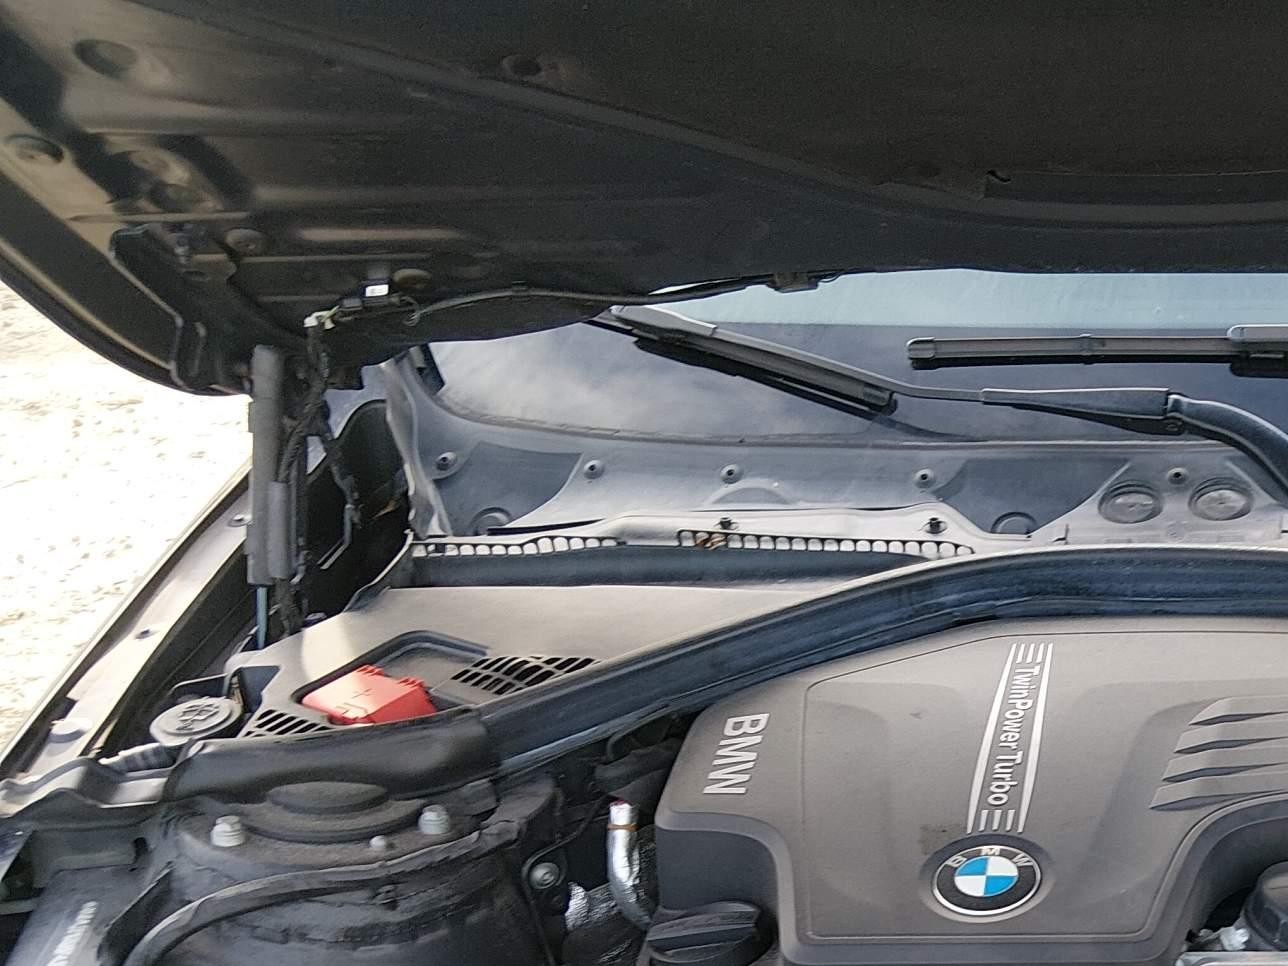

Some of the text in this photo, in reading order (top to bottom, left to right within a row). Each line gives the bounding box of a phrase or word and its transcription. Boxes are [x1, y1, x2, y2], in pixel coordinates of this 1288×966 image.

[703, 712, 770, 795] BMW
[987, 665, 1041, 806] TwinPower Turbo
[945, 847, 1035, 868] BMW
